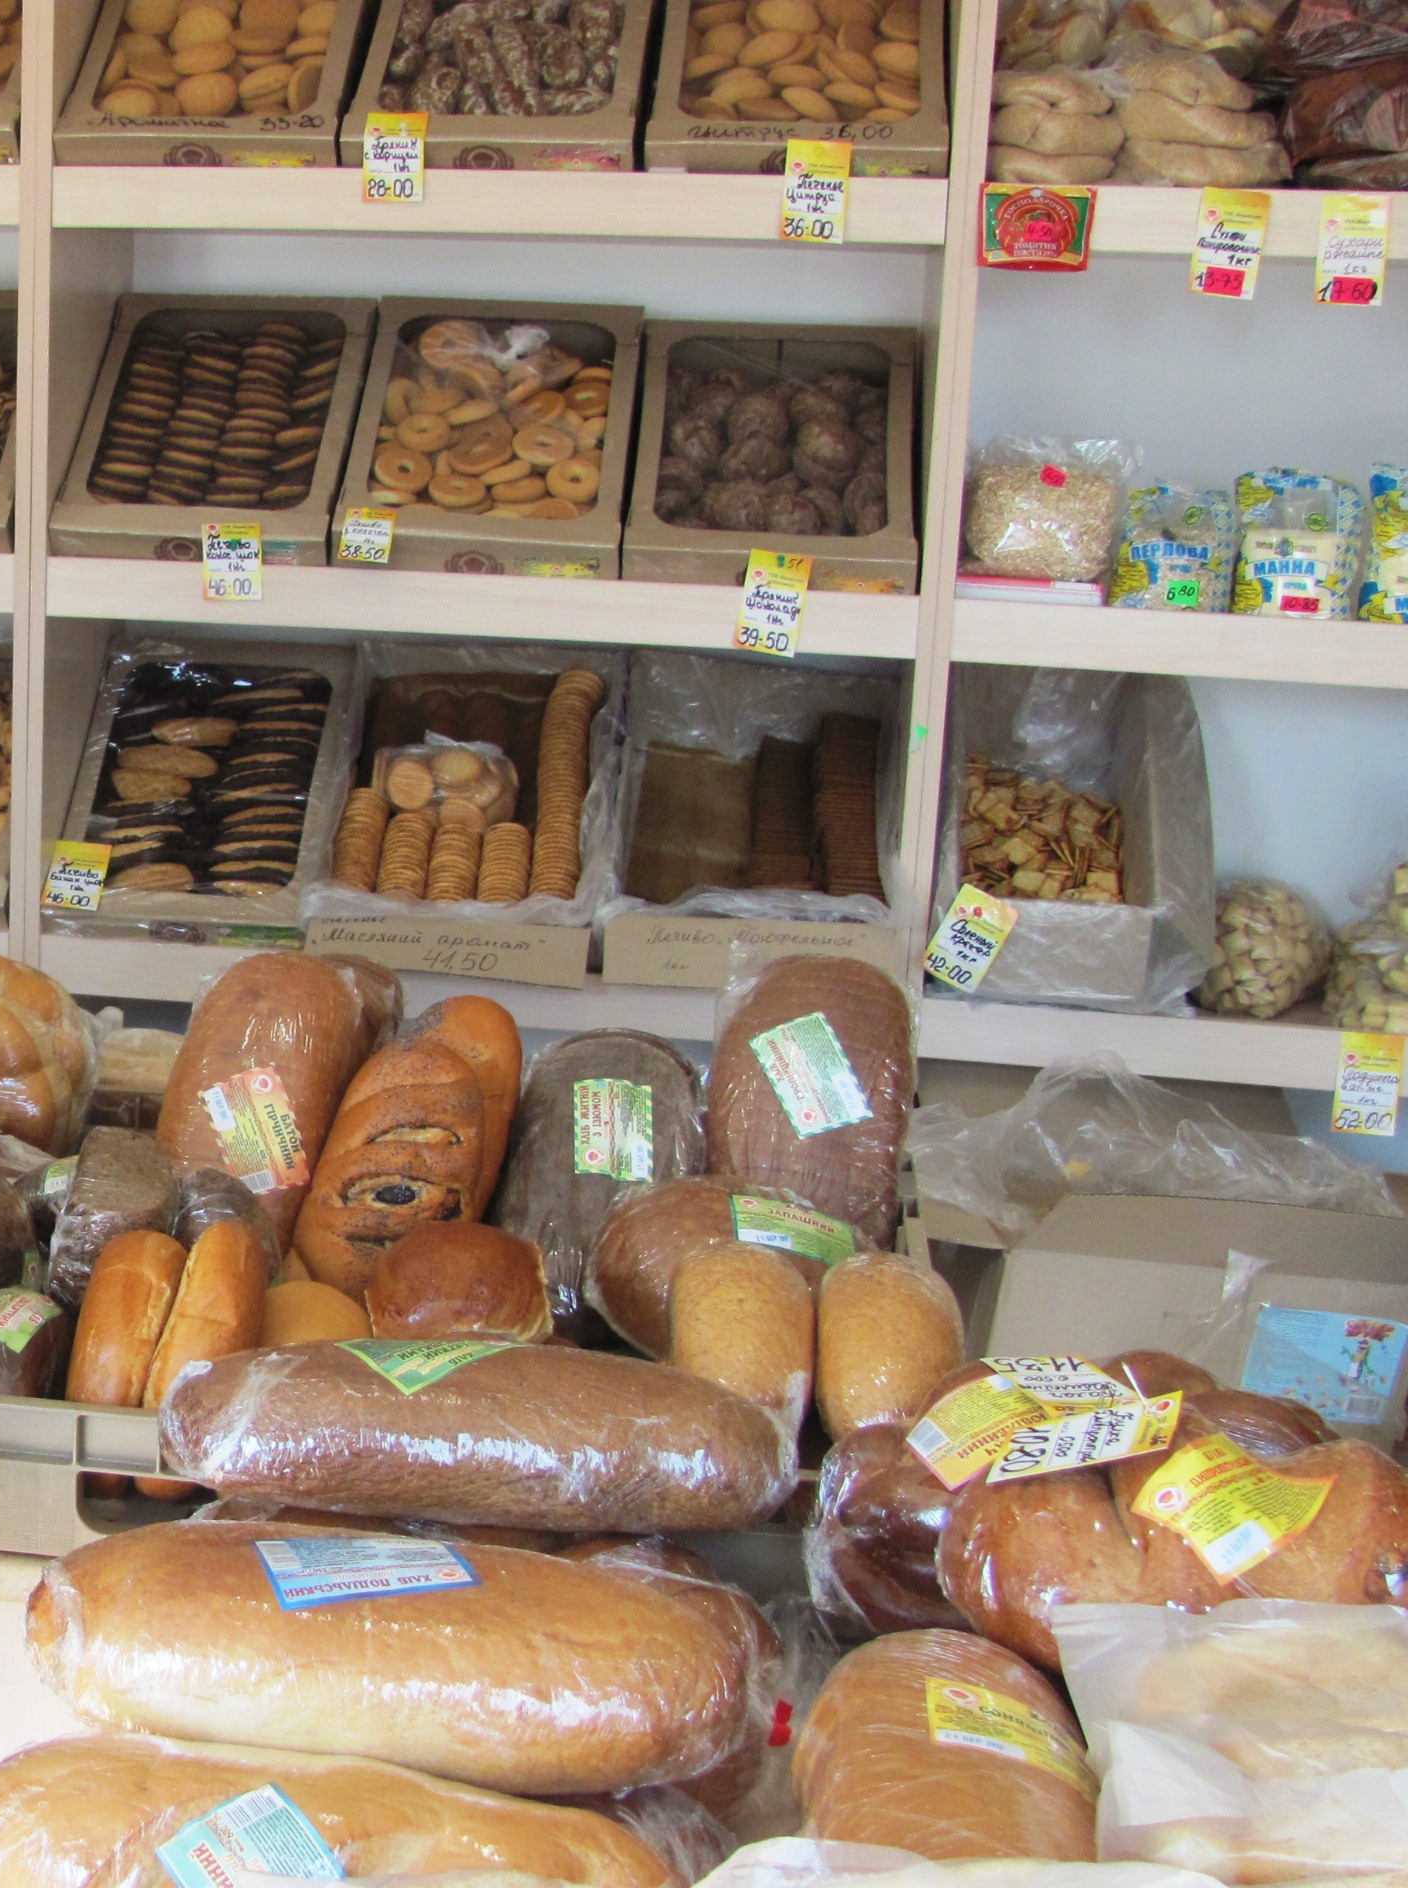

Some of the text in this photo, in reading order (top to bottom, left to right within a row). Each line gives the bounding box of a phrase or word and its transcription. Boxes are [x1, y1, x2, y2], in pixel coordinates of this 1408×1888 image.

[368, 178, 414, 198] 28-00
[339, 544, 385, 560] 38-50
[1130, 543, 1210, 561] ПЕРЛОВА
[1253, 560, 1316, 577] МАННА
[736, 626, 790, 652] 39-50
[47, 892, 91, 907] 46-00
[927, 952, 973, 984] 42-00
[592, 1091, 602, 1127] ІЗЮМОМ
[280, 1113, 301, 1153] БАТОН
[580, 1124, 591, 1145] ХЛІБ
[993, 1356, 1087, 1374] 11-35
[284, 1577, 392, 1600] ПОДІЛЬСЬКИЙ
[399, 1574, 433, 1586] ХЛІБ
